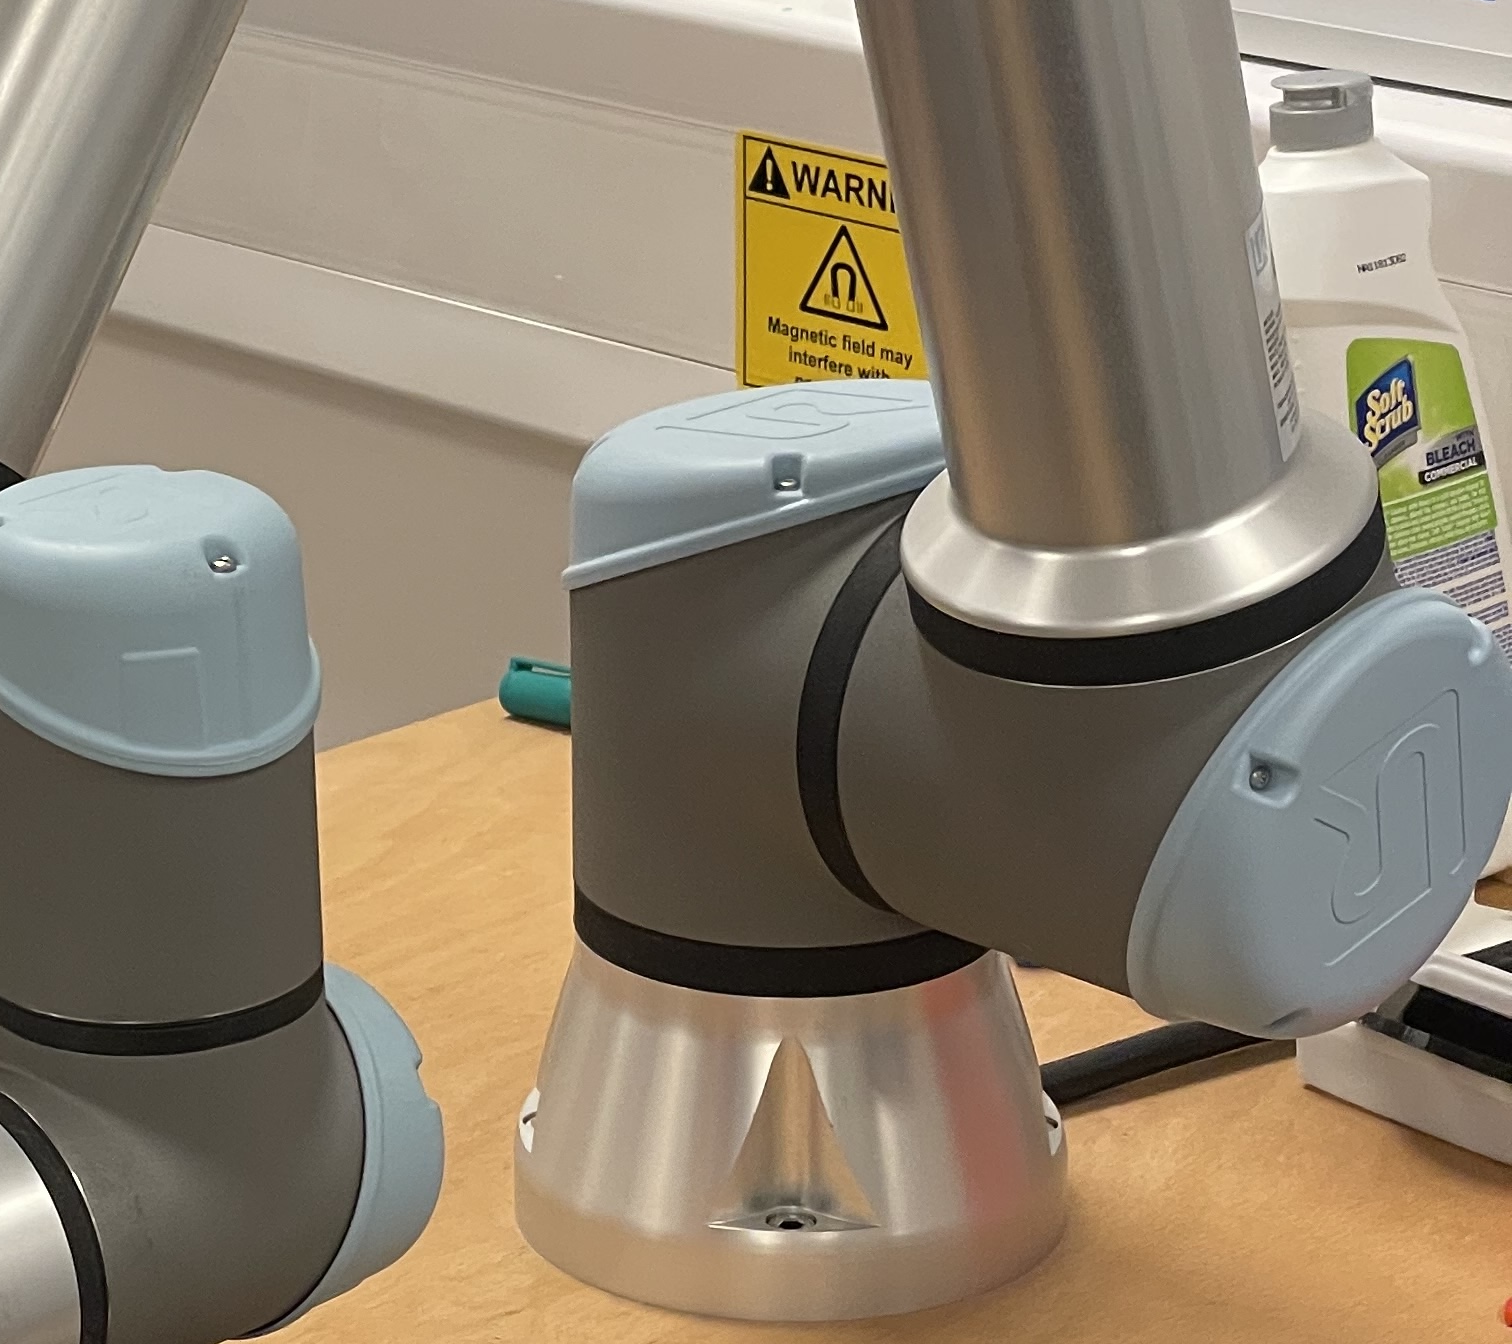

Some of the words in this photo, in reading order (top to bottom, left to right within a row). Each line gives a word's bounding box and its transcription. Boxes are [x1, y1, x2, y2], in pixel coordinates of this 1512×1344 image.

[767, 315, 837, 348] Magnetic
[842, 334, 876, 358] field
[880, 346, 913, 370] may
[857, 366, 890, 379] with
[1366, 377, 1406, 421] Soft
[1363, 394, 1414, 451] Scrub
[1425, 437, 1476, 467] BLEACH
